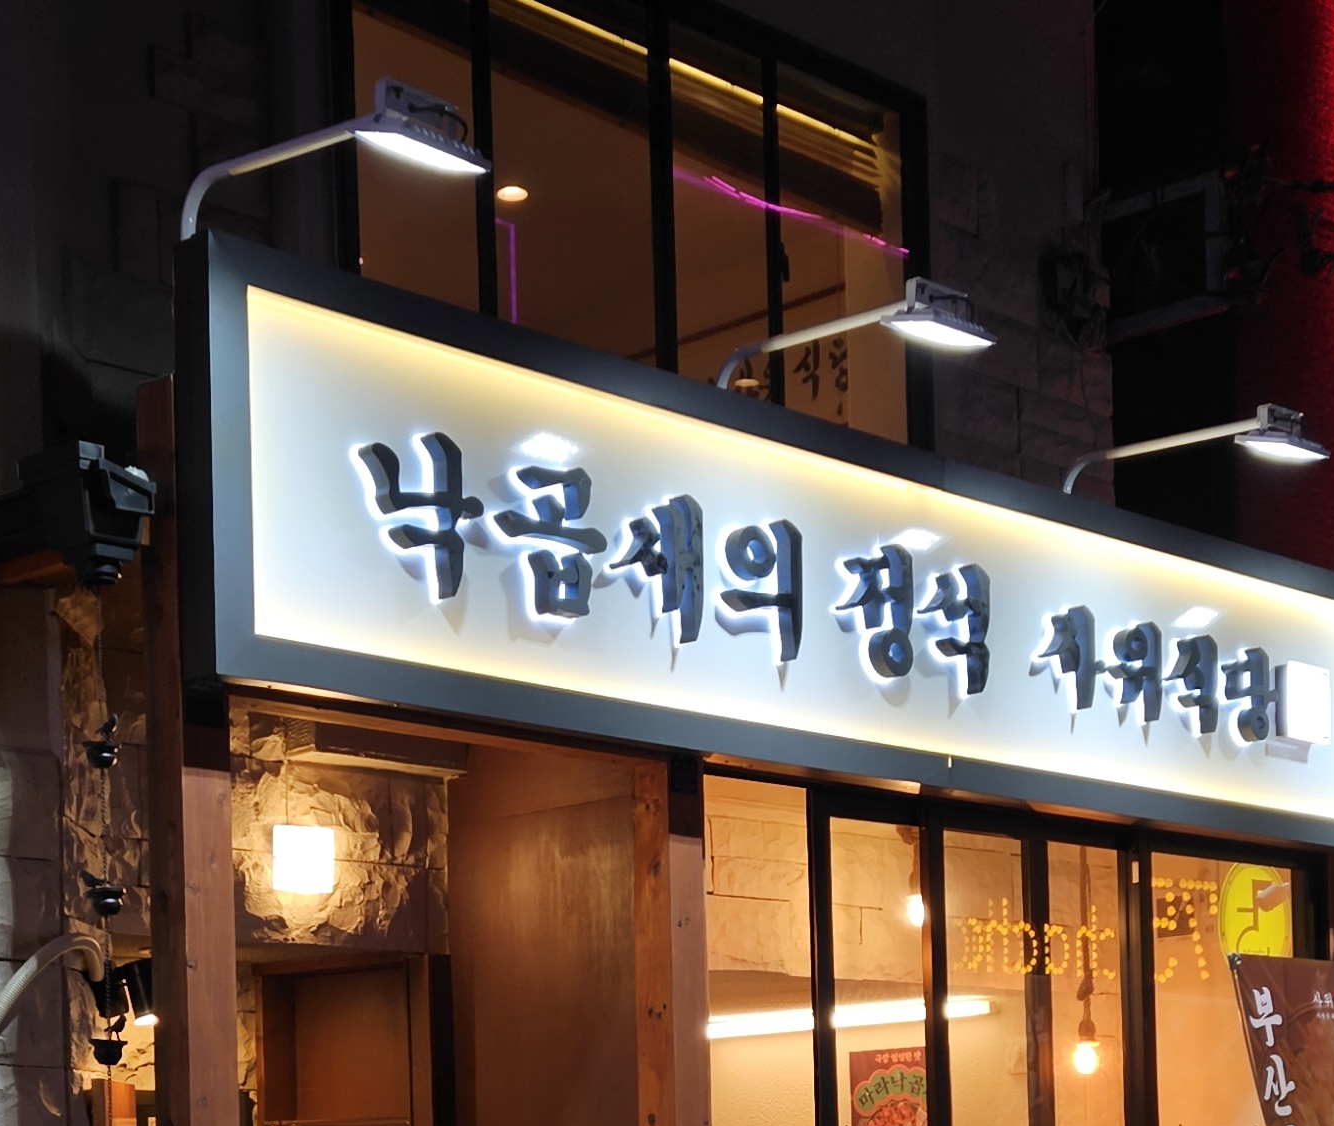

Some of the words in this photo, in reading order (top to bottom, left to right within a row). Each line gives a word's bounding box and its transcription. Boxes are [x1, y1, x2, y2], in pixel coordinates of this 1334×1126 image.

[357, 432, 803, 663] 낙곱새의
[835, 543, 990, 695] 정식
[1038, 604, 1280, 742] 사위식당
[858, 1072, 926, 1107] 마라낙곱
